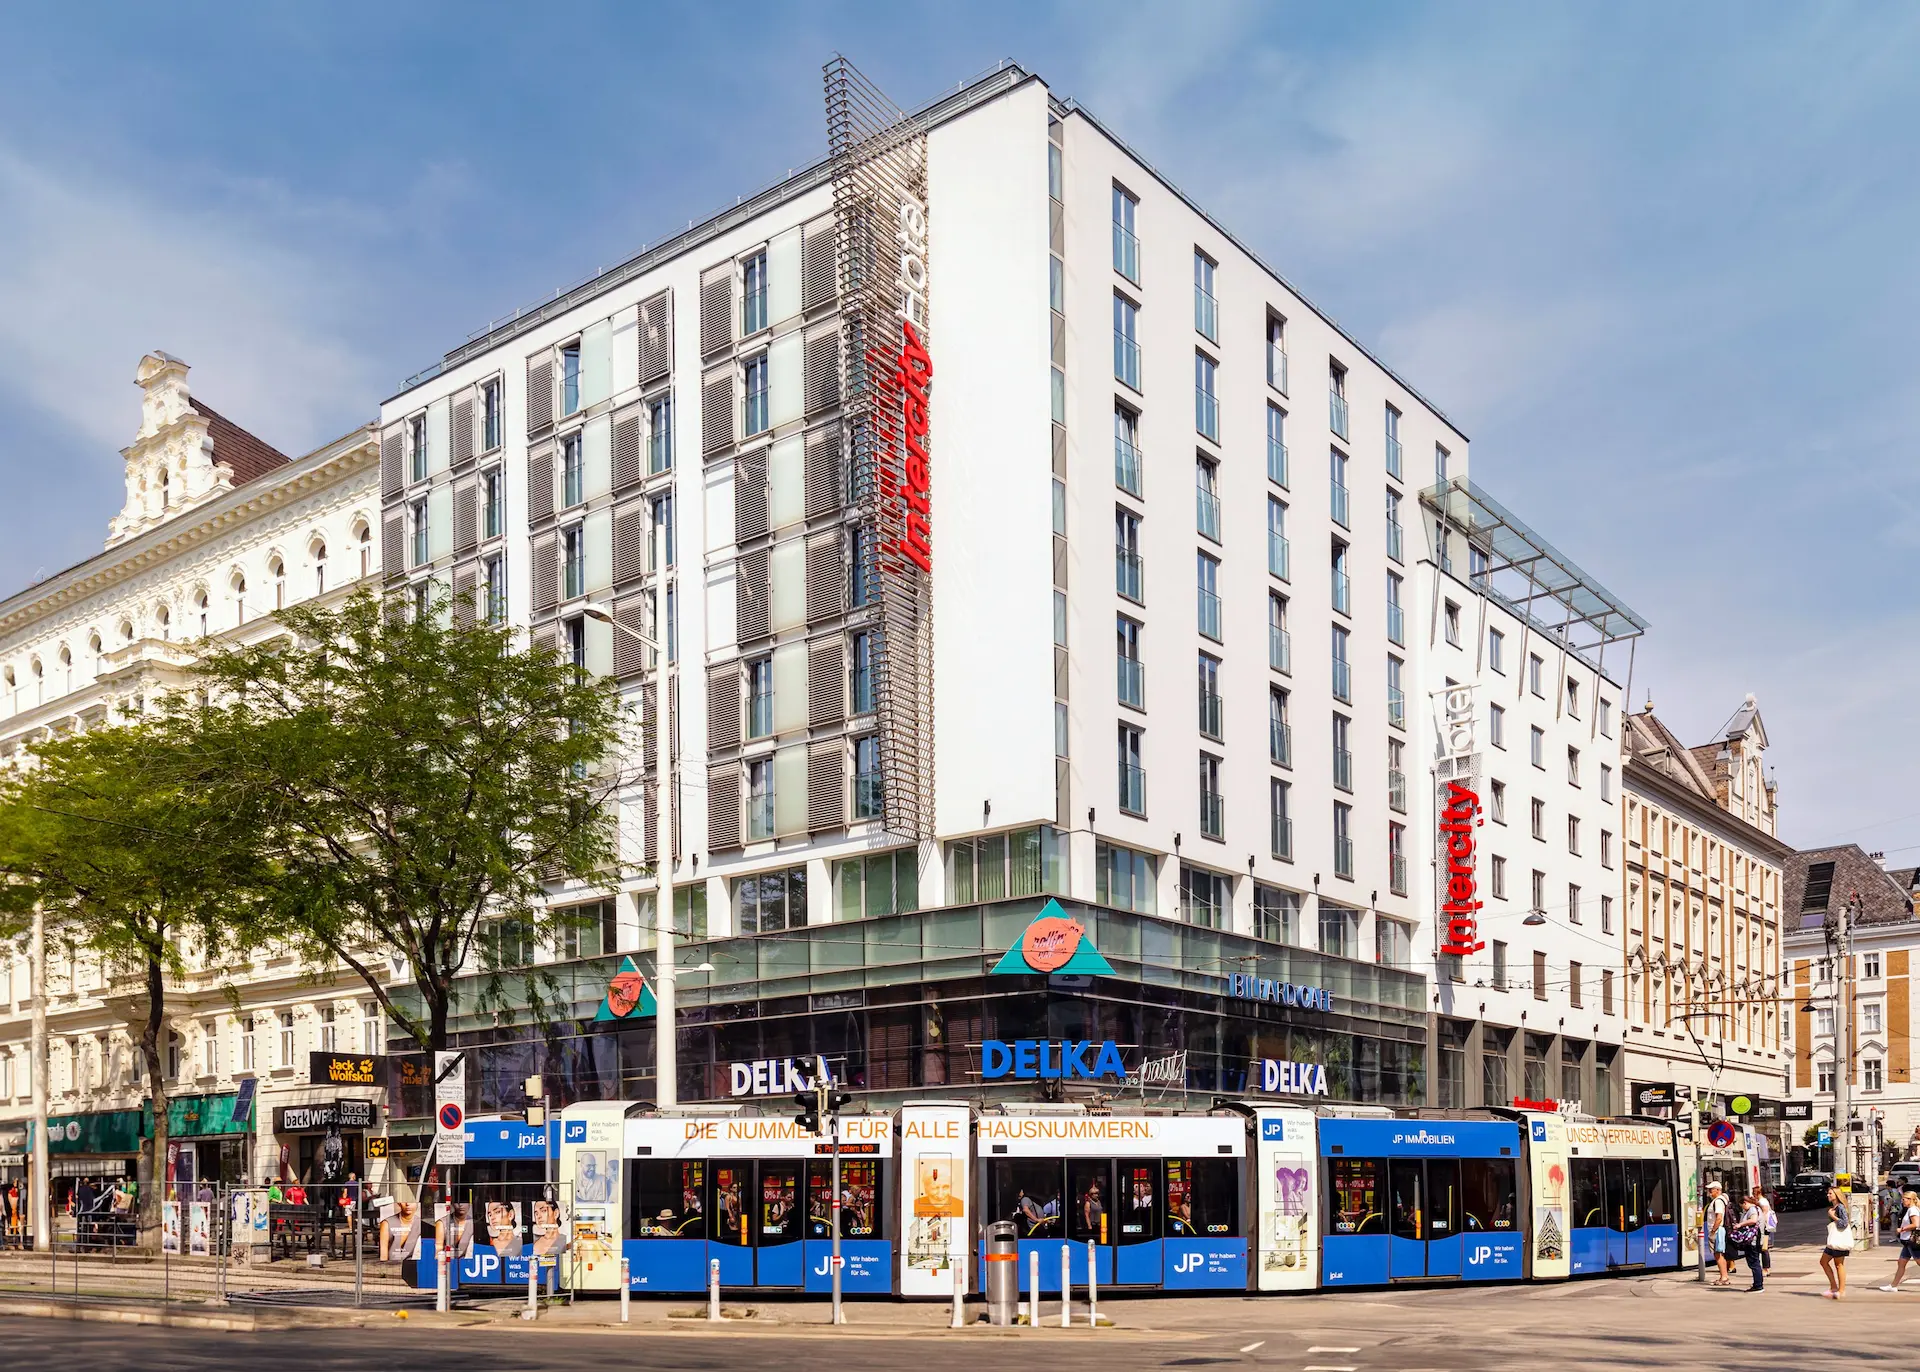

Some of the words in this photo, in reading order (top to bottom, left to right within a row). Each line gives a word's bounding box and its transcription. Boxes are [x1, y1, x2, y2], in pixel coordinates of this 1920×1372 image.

[895, 183, 927, 333] Hotel
[896, 321, 933, 572] Intercity
[1440, 782, 1480, 956] Intercity
[328, 1059, 354, 1071] Jack
[981, 1040, 1128, 1079] DELKA
[328, 1070, 374, 1083] Wolfskin
[1261, 1059, 1329, 1096] DELKA
[341, 1102, 369, 1115] back
[285, 1109, 310, 1128] back
[342, 1115, 370, 1125] WERK
[567, 1127, 584, 1138] JP
[685, 1122, 718, 1140] DIE
[846, 1119, 888, 1139] FÜR
[905, 1121, 960, 1139] ALLE
[977, 1121, 1154, 1139] HAUSNUMMERN.
[1265, 1124, 1281, 1136] JP
[1534, 1126, 1545, 1137] JP
[1566, 1128, 1599, 1143] UNSER
[1602, 1129, 1656, 1145] VERTRAUEN
[1657, 1130, 1673, 1145] GIB
[518, 1133, 547, 1149] jpi.a
[1392, 1134, 1403, 1143] JP
[1405, 1134, 1455, 1144] IMMOBILIEN
[816, 1144, 822, 1154] 5
[1649, 1237, 1661, 1253] JP
[1174, 1253, 1205, 1273] JP
[1469, 1246, 1491, 1264] JP
[464, 1255, 499, 1278] JP
[814, 1256, 846, 1276] JP
[632, 1276, 647, 1284] jpi.at
